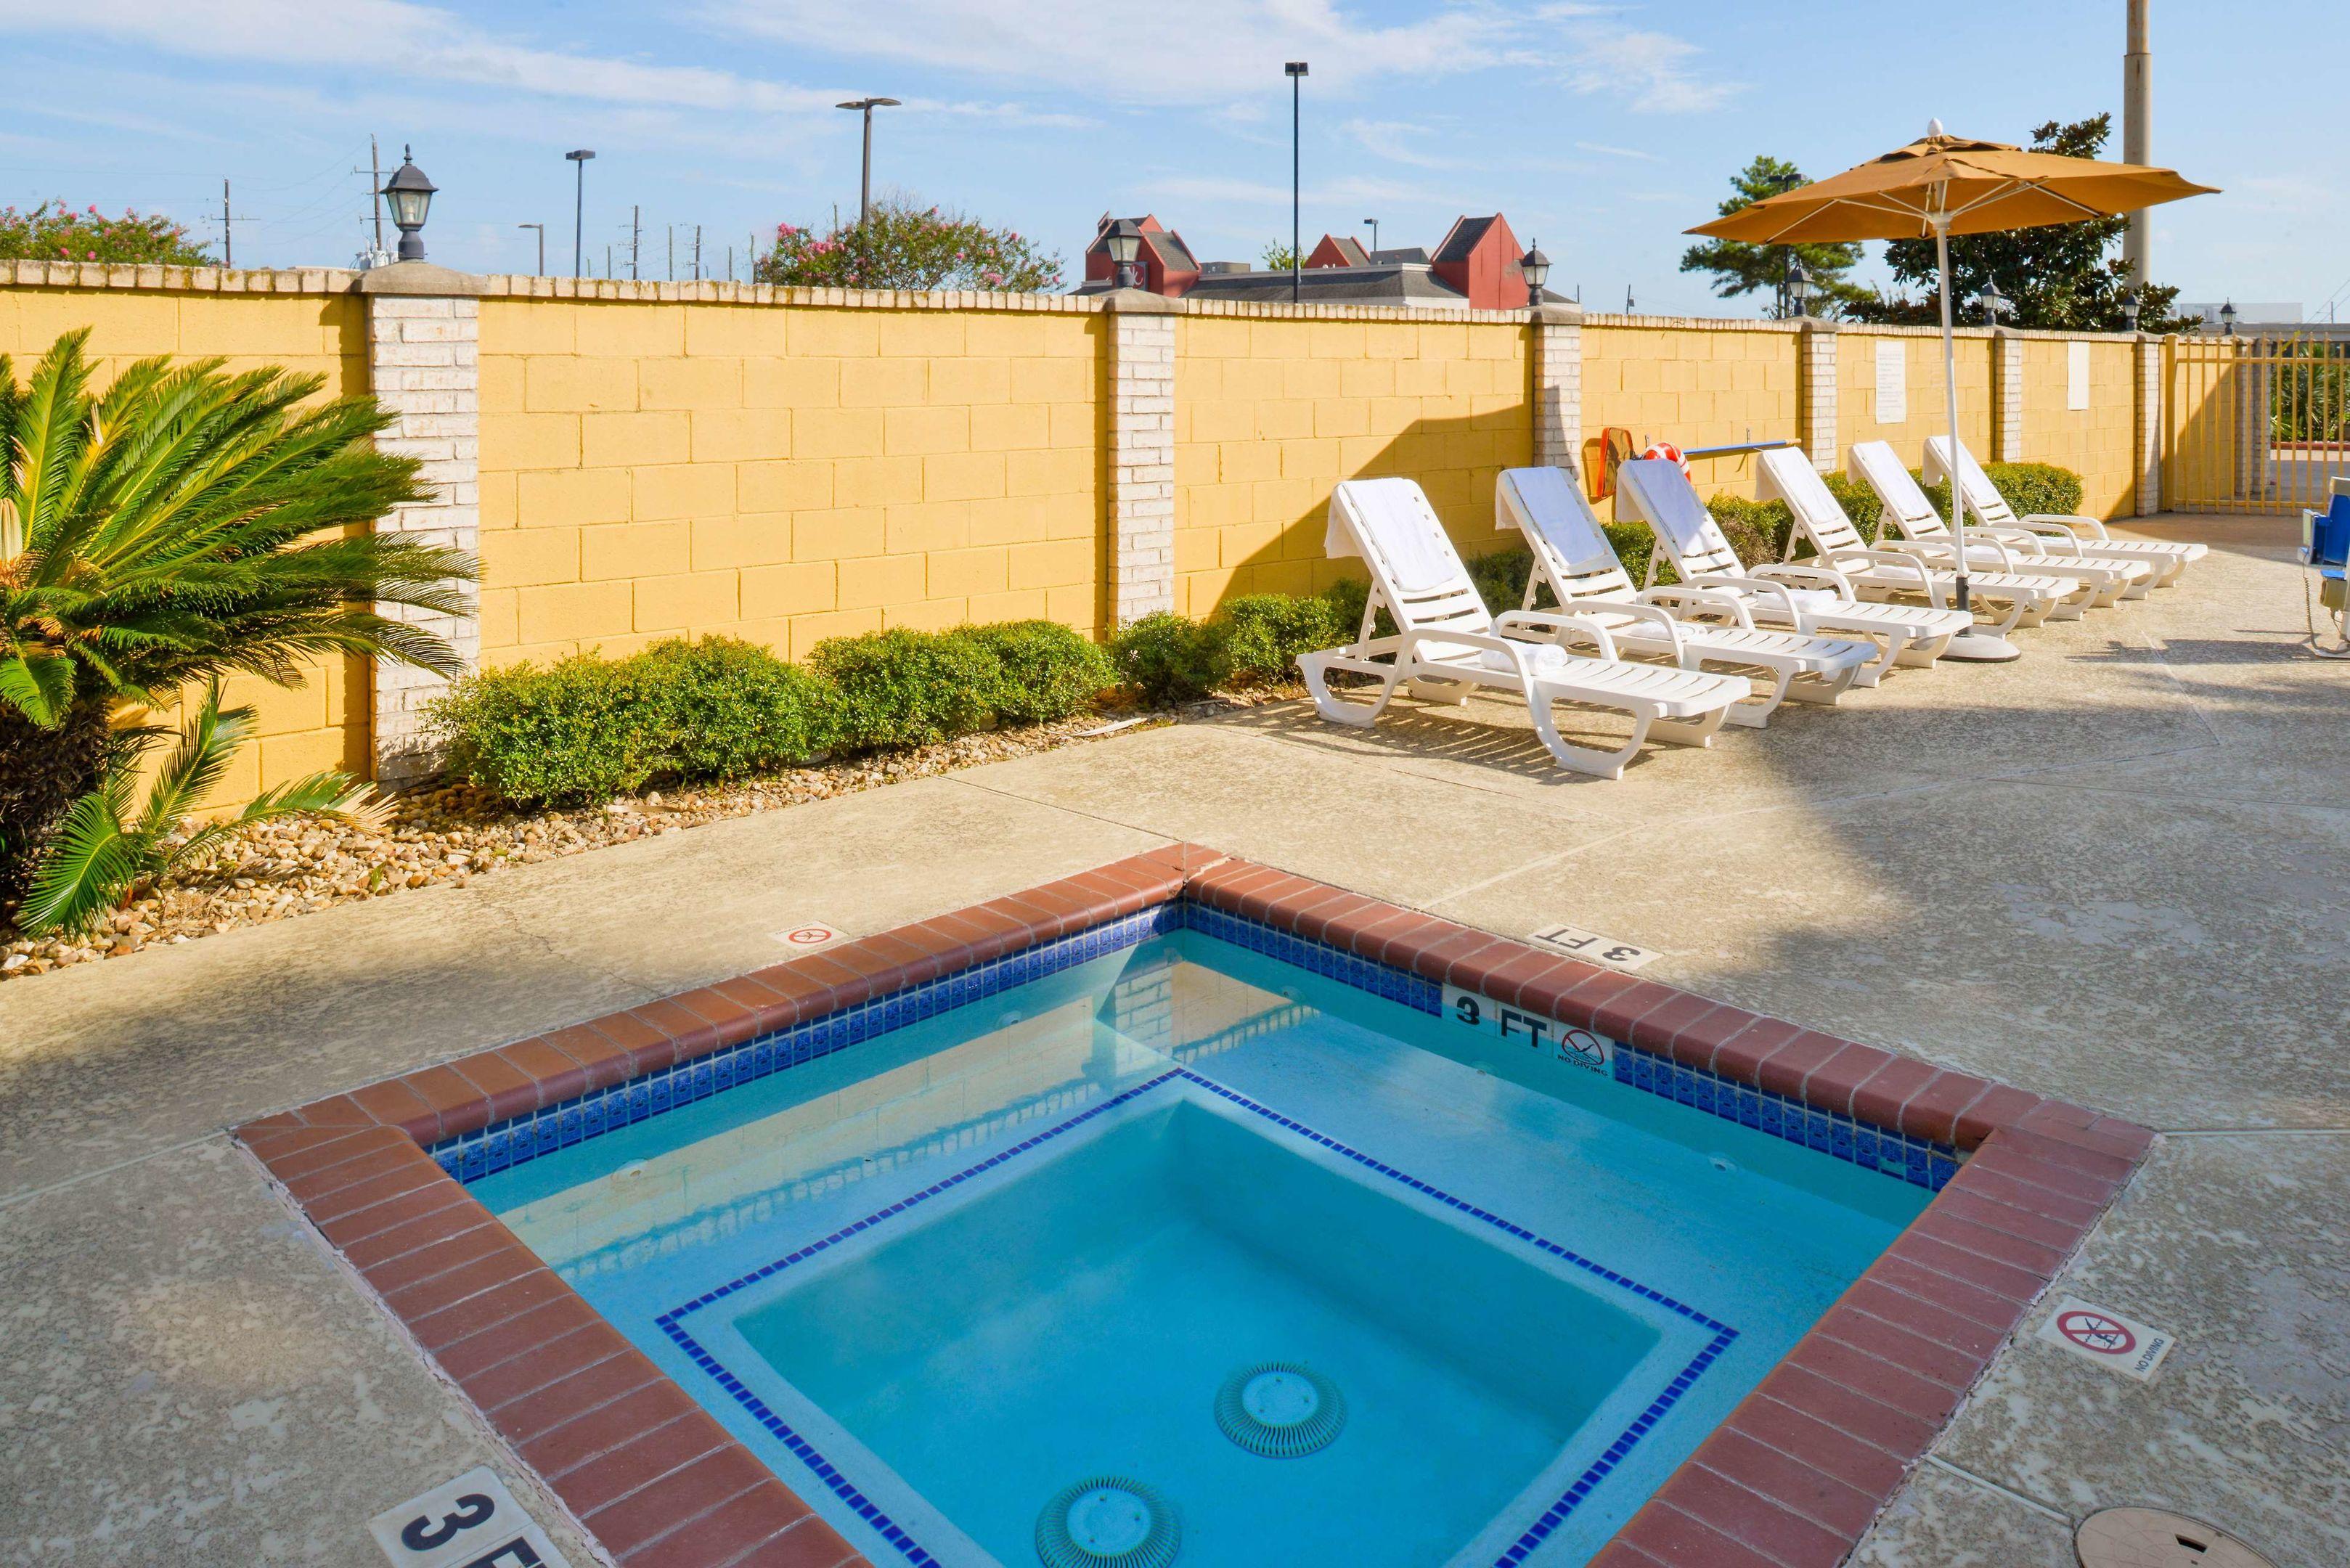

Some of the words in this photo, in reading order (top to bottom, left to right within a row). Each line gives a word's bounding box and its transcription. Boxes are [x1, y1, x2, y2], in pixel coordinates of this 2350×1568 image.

[1534, 928, 1599, 950] FT
[1602, 946, 1641, 962] 3
[1456, 995, 1481, 1026] 3
[1501, 1008, 1548, 1048] FT
[1557, 1054, 1571, 1063] NO
[1573, 1060, 1609, 1077] DIVING
[2134, 1360, 2149, 1372] NO
[2142, 1338, 2164, 1361] DIVING
[401, 1493, 495, 1551] 3
